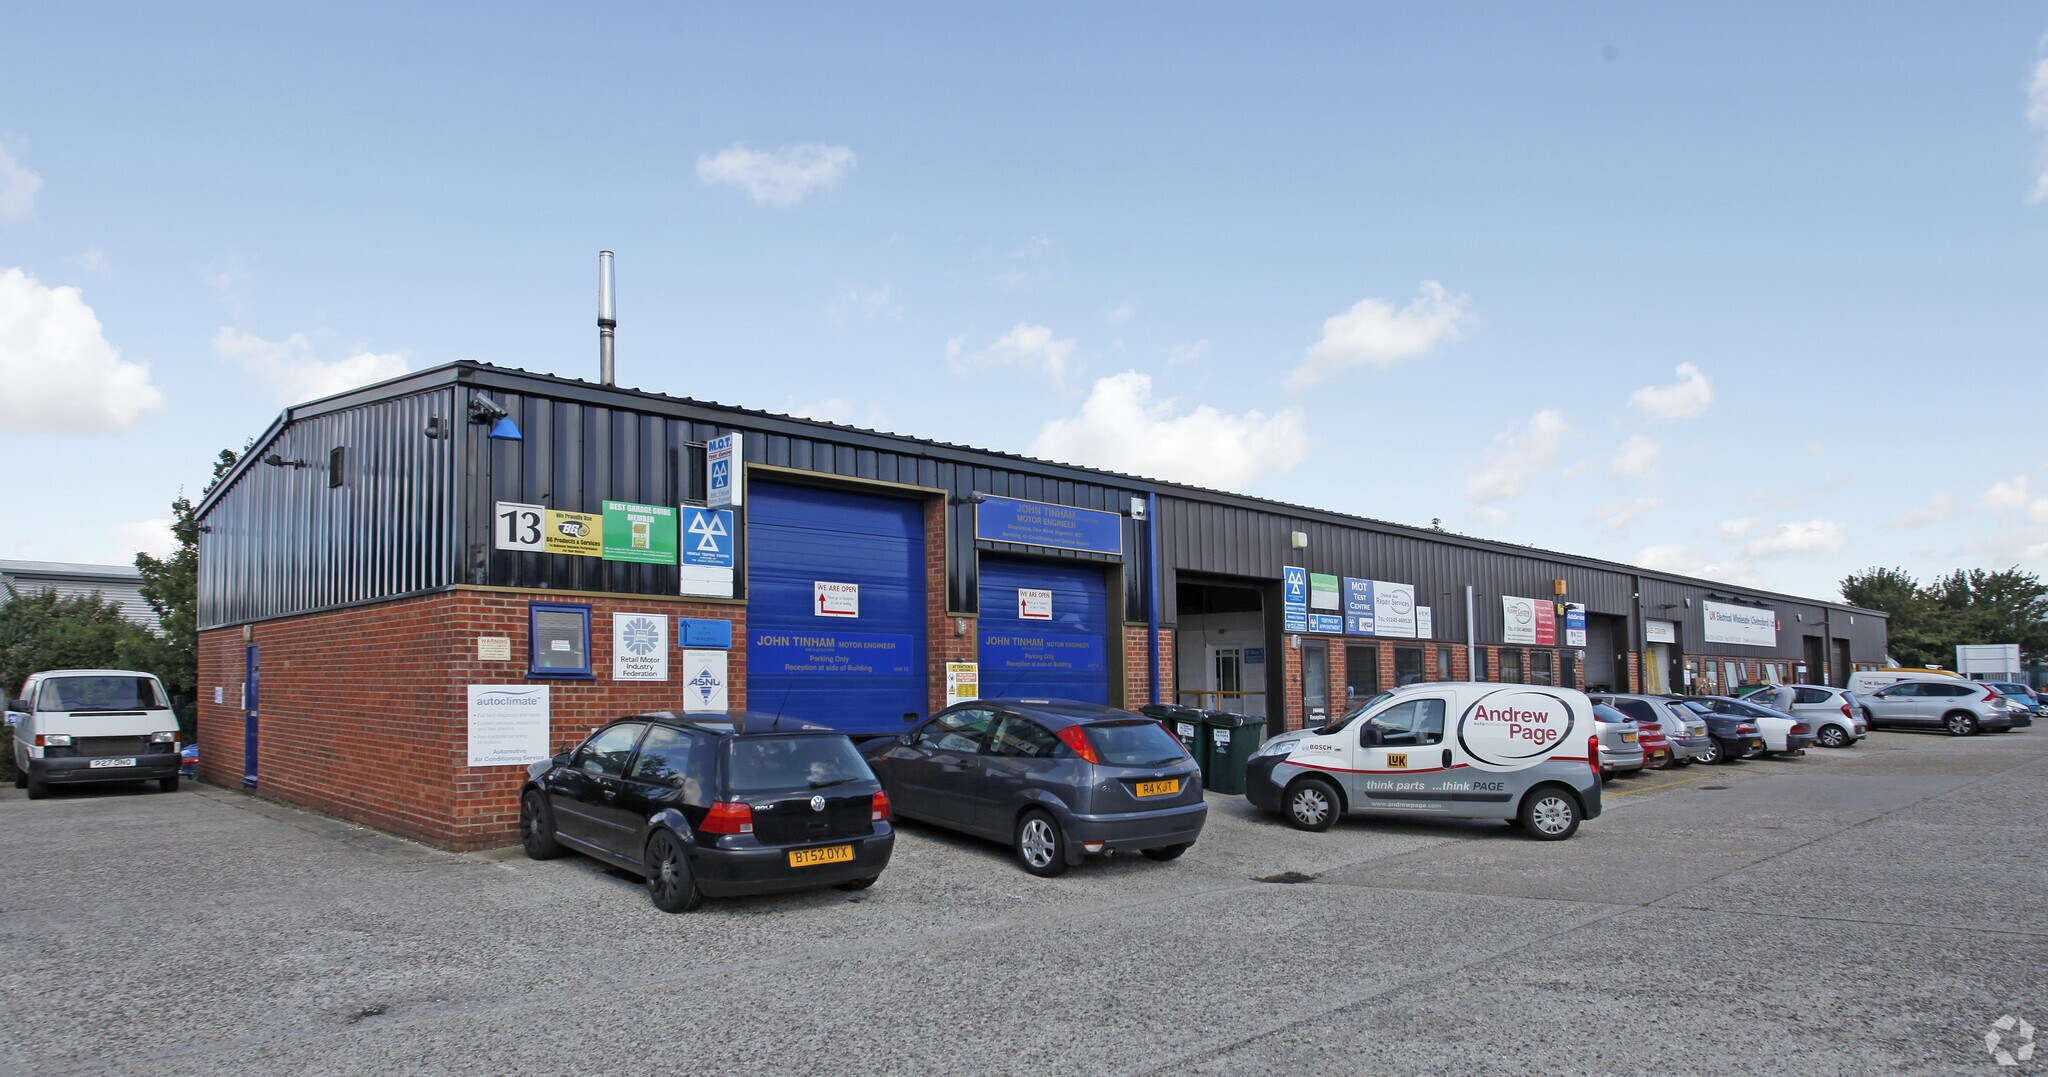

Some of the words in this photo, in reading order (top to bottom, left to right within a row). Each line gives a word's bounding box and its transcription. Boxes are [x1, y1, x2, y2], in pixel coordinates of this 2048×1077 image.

[709, 436, 732, 452] M.O.T.
[609, 503, 626, 511] BEST
[627, 504, 652, 514] GARAGE
[653, 507, 672, 516] GUIDE
[1016, 504, 1041, 515] JOHN
[1043, 507, 1076, 519] TINHAM
[564, 513, 583, 521] Proudly
[627, 514, 655, 523] MEMBER
[1016, 514, 1042, 525] MOTOR
[1044, 518, 1077, 529] ENGINEER
[500, 510, 542, 545] 13
[561, 524, 581, 538] BG
[1352, 582, 1368, 592] MOT
[1354, 593, 1366, 601] TEST
[1376, 597, 1391, 606] Repair
[1391, 599, 1410, 607] Services
[1350, 602, 1371, 610] CENTRE
[1710, 611, 1716, 620] UK
[1717, 612, 1732, 622] Electrical
[757, 636, 790, 647] JOHN
[793, 637, 835, 648] TINHAM
[864, 642, 896, 650] ENGINEER
[986, 636, 1010, 646] JOHN
[1012, 638, 1044, 647] TINHAM
[810, 655, 834, 663] Parking
[835, 656, 849, 664] Only
[785, 664, 817, 672] Reception
[848, 665, 873, 673] Building
[1474, 705, 1549, 724] Andrew
[1510, 724, 1557, 746] Page
[1143, 784, 1155, 794] R4
[1157, 782, 1172, 792] KJT
[1366, 780, 1394, 790] think
[1396, 781, 1425, 792] parts
[1432, 781, 1470, 791] ...think
[1473, 782, 1504, 791] PAGE
[1371, 801, 1442, 809] www.andrewpage.com
[795, 850, 825, 863] BT52
[828, 846, 848, 860] OYX
